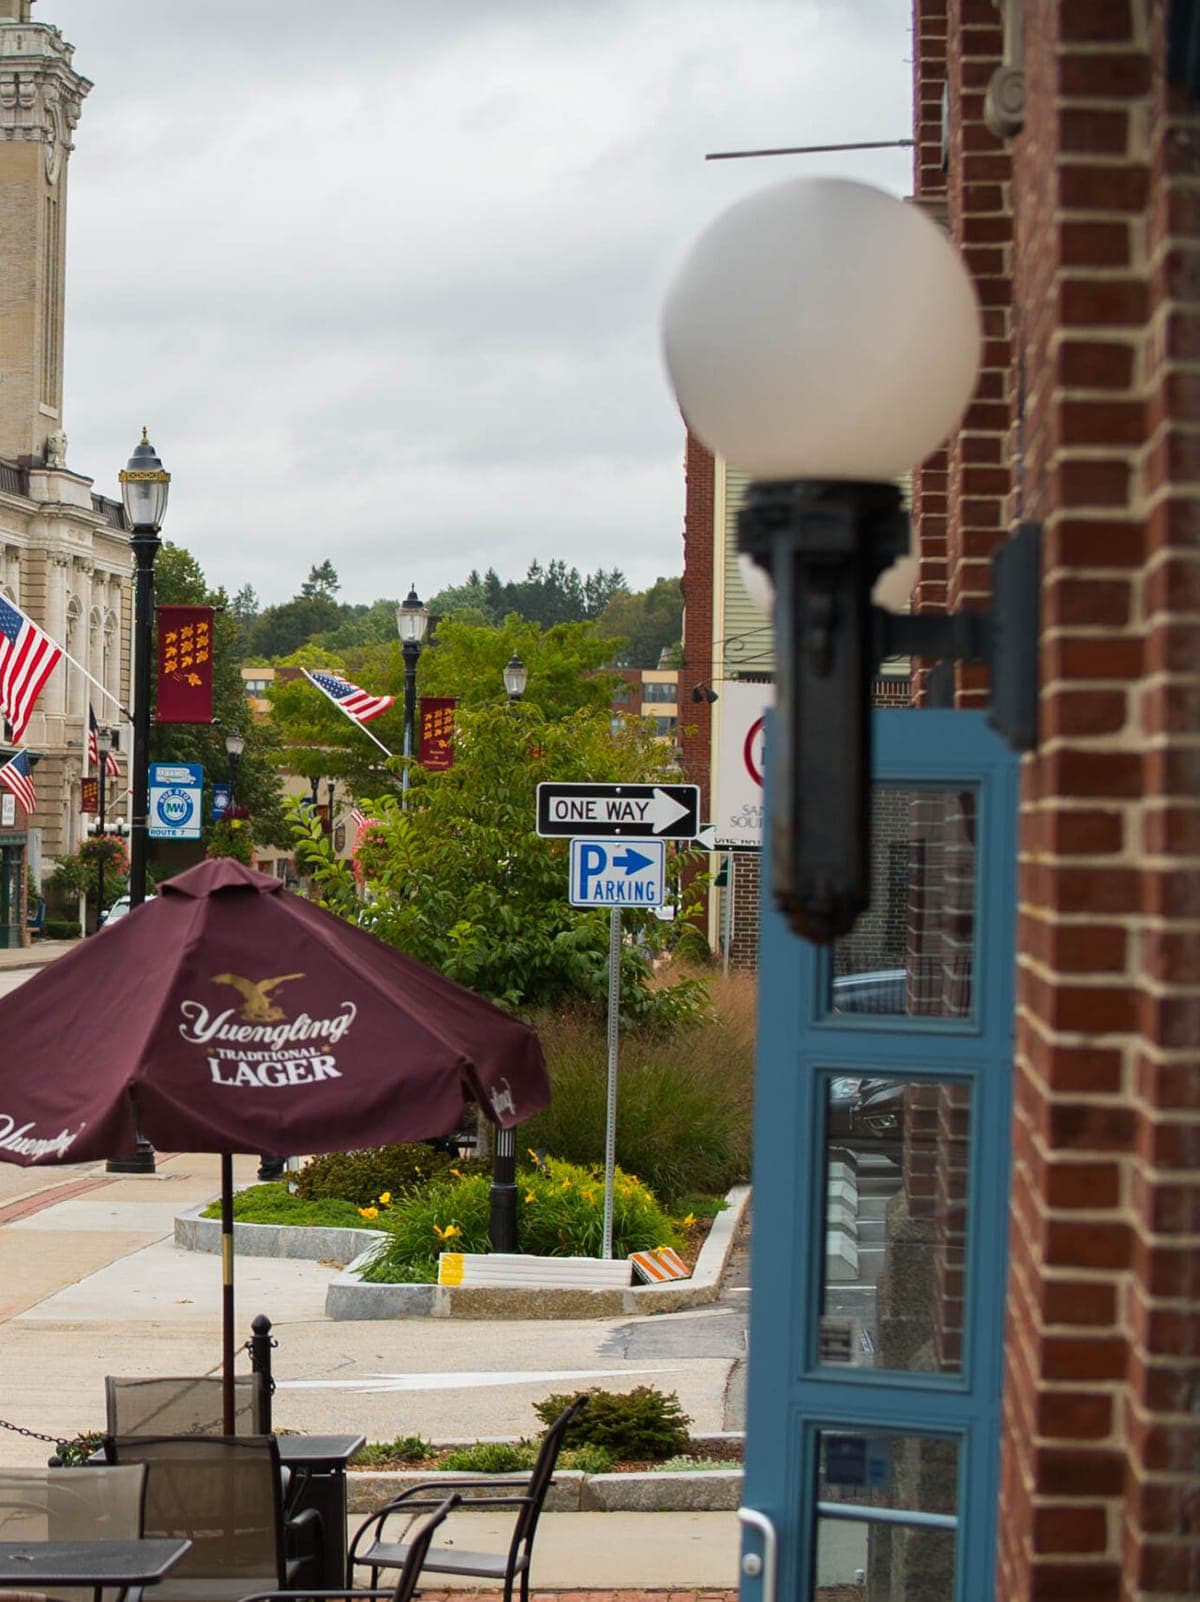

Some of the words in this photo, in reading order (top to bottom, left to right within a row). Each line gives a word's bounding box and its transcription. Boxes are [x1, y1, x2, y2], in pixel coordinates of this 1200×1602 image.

[159, 789, 174, 804] BUS
[174, 788, 193, 804] STOP
[555, 800, 598, 821] ONE
[606, 800, 650, 821] WAY
[150, 829, 177, 837] ROUTE
[579, 844, 656, 902] PARKING
[178, 999, 358, 1050] Yuengling
[216, 1046, 321, 1062] TRADITIONAL
[207, 1055, 343, 1088] LAGER
